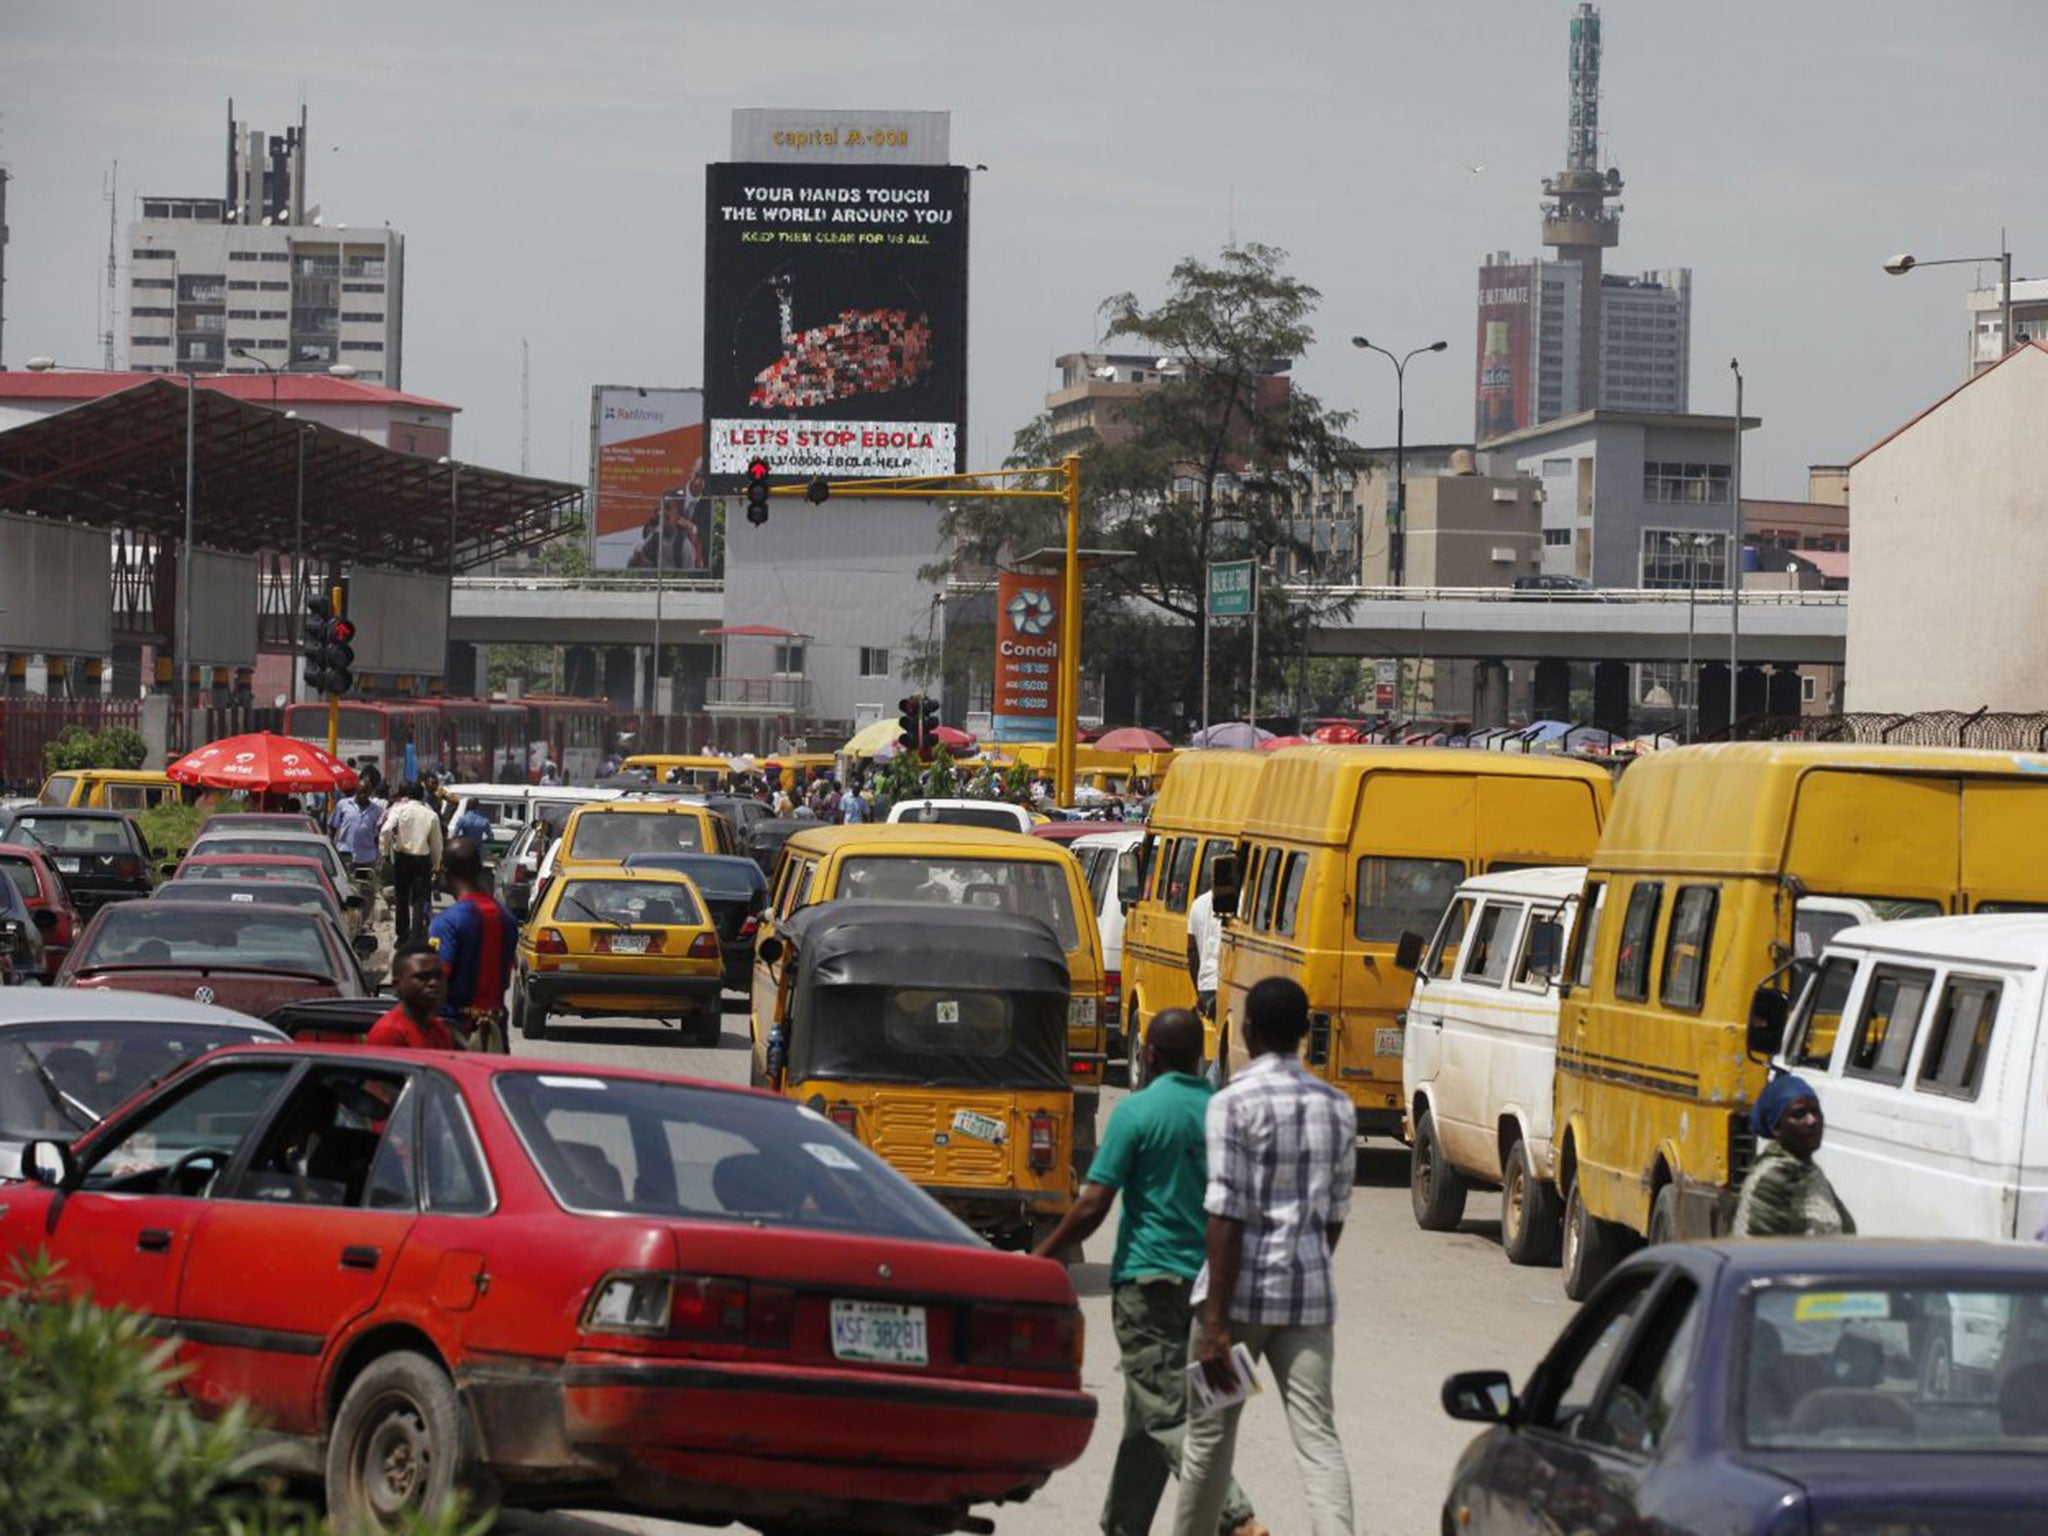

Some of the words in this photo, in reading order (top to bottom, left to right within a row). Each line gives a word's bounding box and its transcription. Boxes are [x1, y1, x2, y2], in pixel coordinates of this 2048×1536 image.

[744, 187, 793, 202] YOUR
[800, 188, 861, 202] HANDS
[867, 189, 930, 203] TOUCH
[722, 206, 757, 221] THE
[763, 207, 827, 222] WORLD
[832, 208, 908, 223] AROUND
[915, 209, 953, 224] YOU
[859, 233, 884, 244] FOR
[907, 234, 929, 245] ALL
[729, 428, 789, 447] LET'S
[796, 430, 855, 447] STOP
[861, 431, 933, 448] EBOLA
[1000, 640, 1057, 658] Conoil
[223, 764, 253, 775] airtel
[283, 767, 312, 776] airtel
